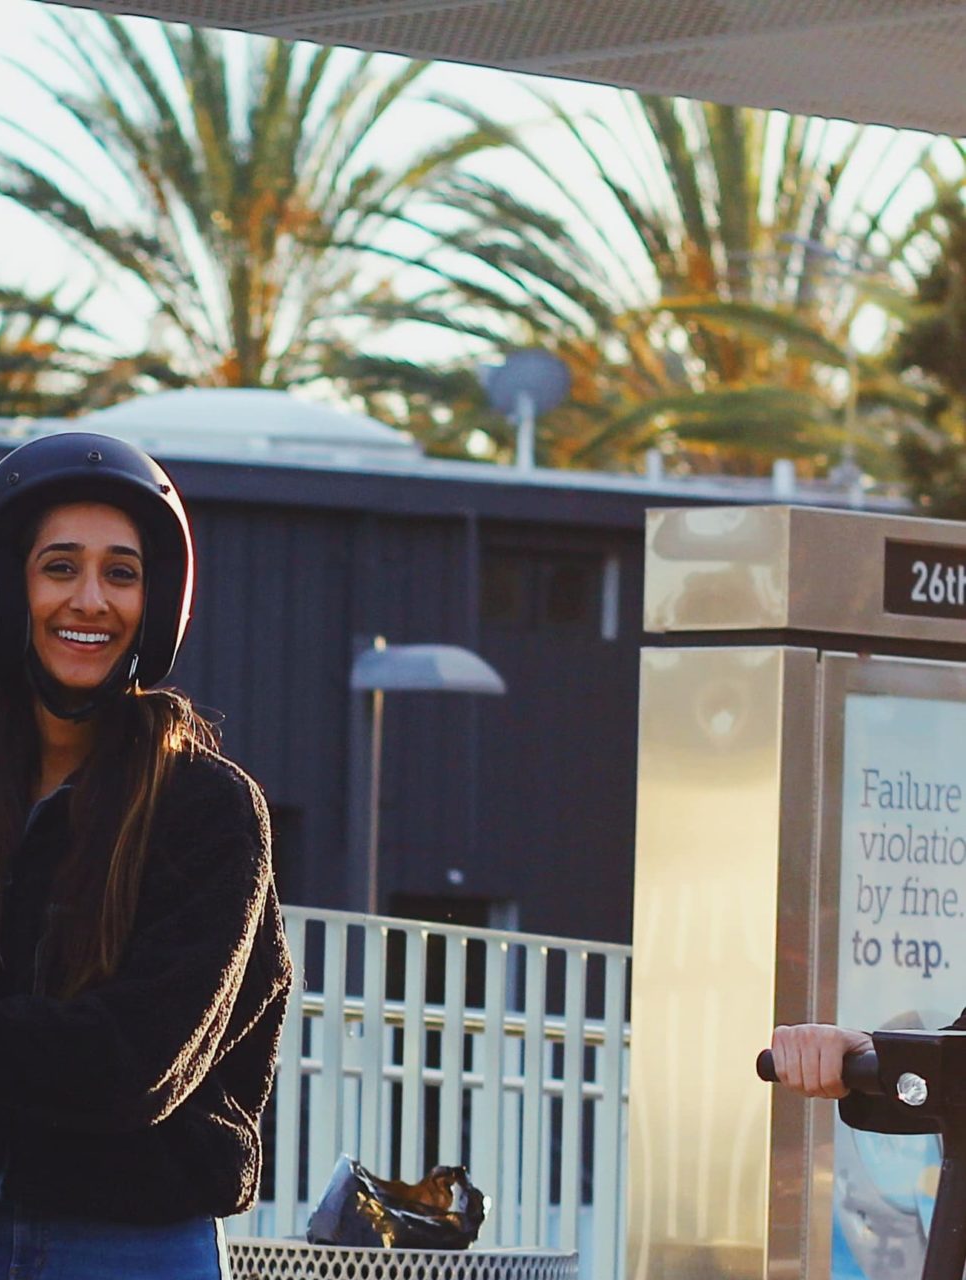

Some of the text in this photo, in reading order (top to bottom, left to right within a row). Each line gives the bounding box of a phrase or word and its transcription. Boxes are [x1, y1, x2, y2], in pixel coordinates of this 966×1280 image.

[860, 768, 962, 813] Failure
[857, 874, 964, 924] by fine.
[852, 930, 950, 978] to tap.
